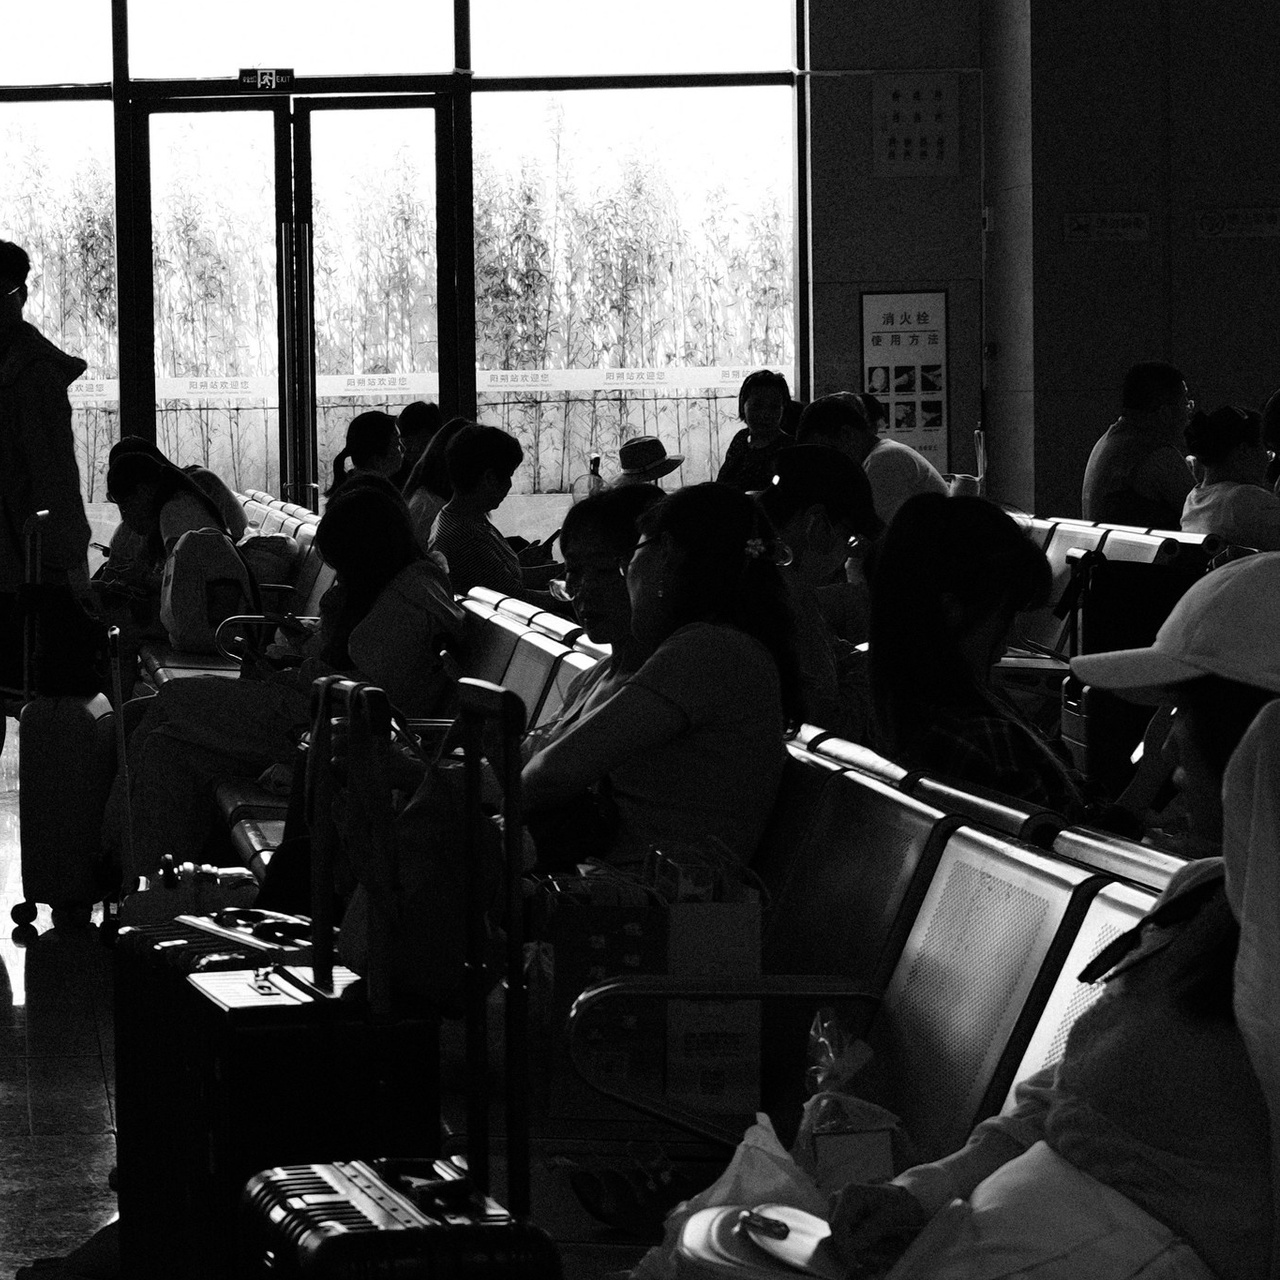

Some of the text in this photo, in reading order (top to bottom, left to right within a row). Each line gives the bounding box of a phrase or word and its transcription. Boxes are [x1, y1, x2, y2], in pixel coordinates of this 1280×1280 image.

[276, 75, 290, 83] EXIT
[882, 311, 930, 326] 消火栓
[871, 334, 939, 347] 使用方法
[489, 373, 550, 383] 阳朔站欢迎您
[605, 371, 665, 381] 阳朔站欢迎您
[189, 381, 249, 390] 阳朔站欢迎您
[346, 377, 407, 387] 阳朔站欢迎您
